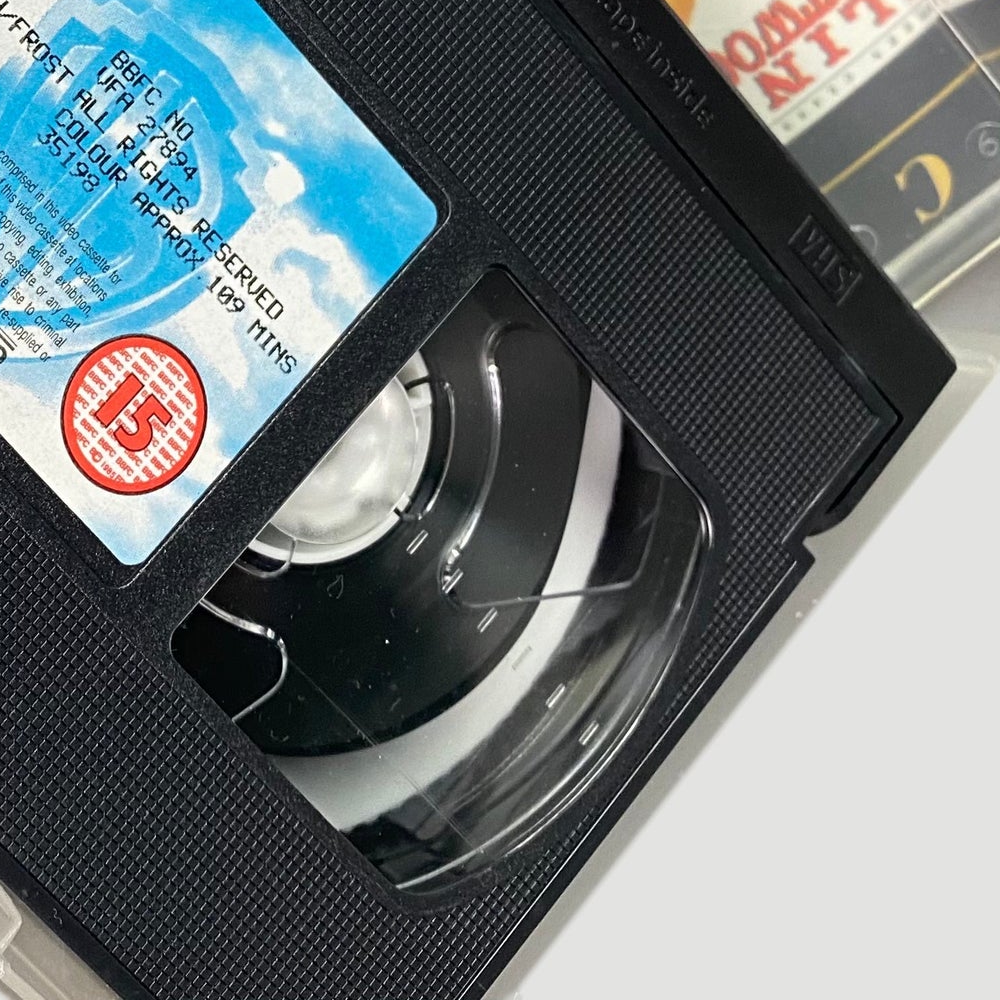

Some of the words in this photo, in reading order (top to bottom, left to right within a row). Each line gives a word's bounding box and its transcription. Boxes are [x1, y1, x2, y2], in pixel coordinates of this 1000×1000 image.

[95, 65, 135, 113] VFA
[136, 114, 198, 182] 27894
[109, 49, 162, 106] BBFC
[162, 108, 194, 141] NO
[647, 37, 713, 128] inside
[36, 123, 100, 193] 35198
[895, 154, 953, 224] C
[0, 182, 17, 203] this
[14, 199, 37, 225] video
[33, 222, 67, 257] cassette
[72, 261, 107, 302] locations
[42, 198, 59, 218] this
[57, 215, 80, 240] video
[77, 238, 115, 273] cassette
[54, 107, 128, 189] COLOUR
[246, 317, 297, 374] MINS
[71, 87, 117, 134] ALL
[115, 134, 192, 215] RIGHTS
[190, 216, 284, 320] RESERVED
[3, 250, 36, 288] cassette
[58, 312, 81, 333] part
[802, 229, 855, 290] VHS
[6, 282, 25, 305] rise
[33, 310, 67, 349] criminal
[95, 373, 172, 452] 15
